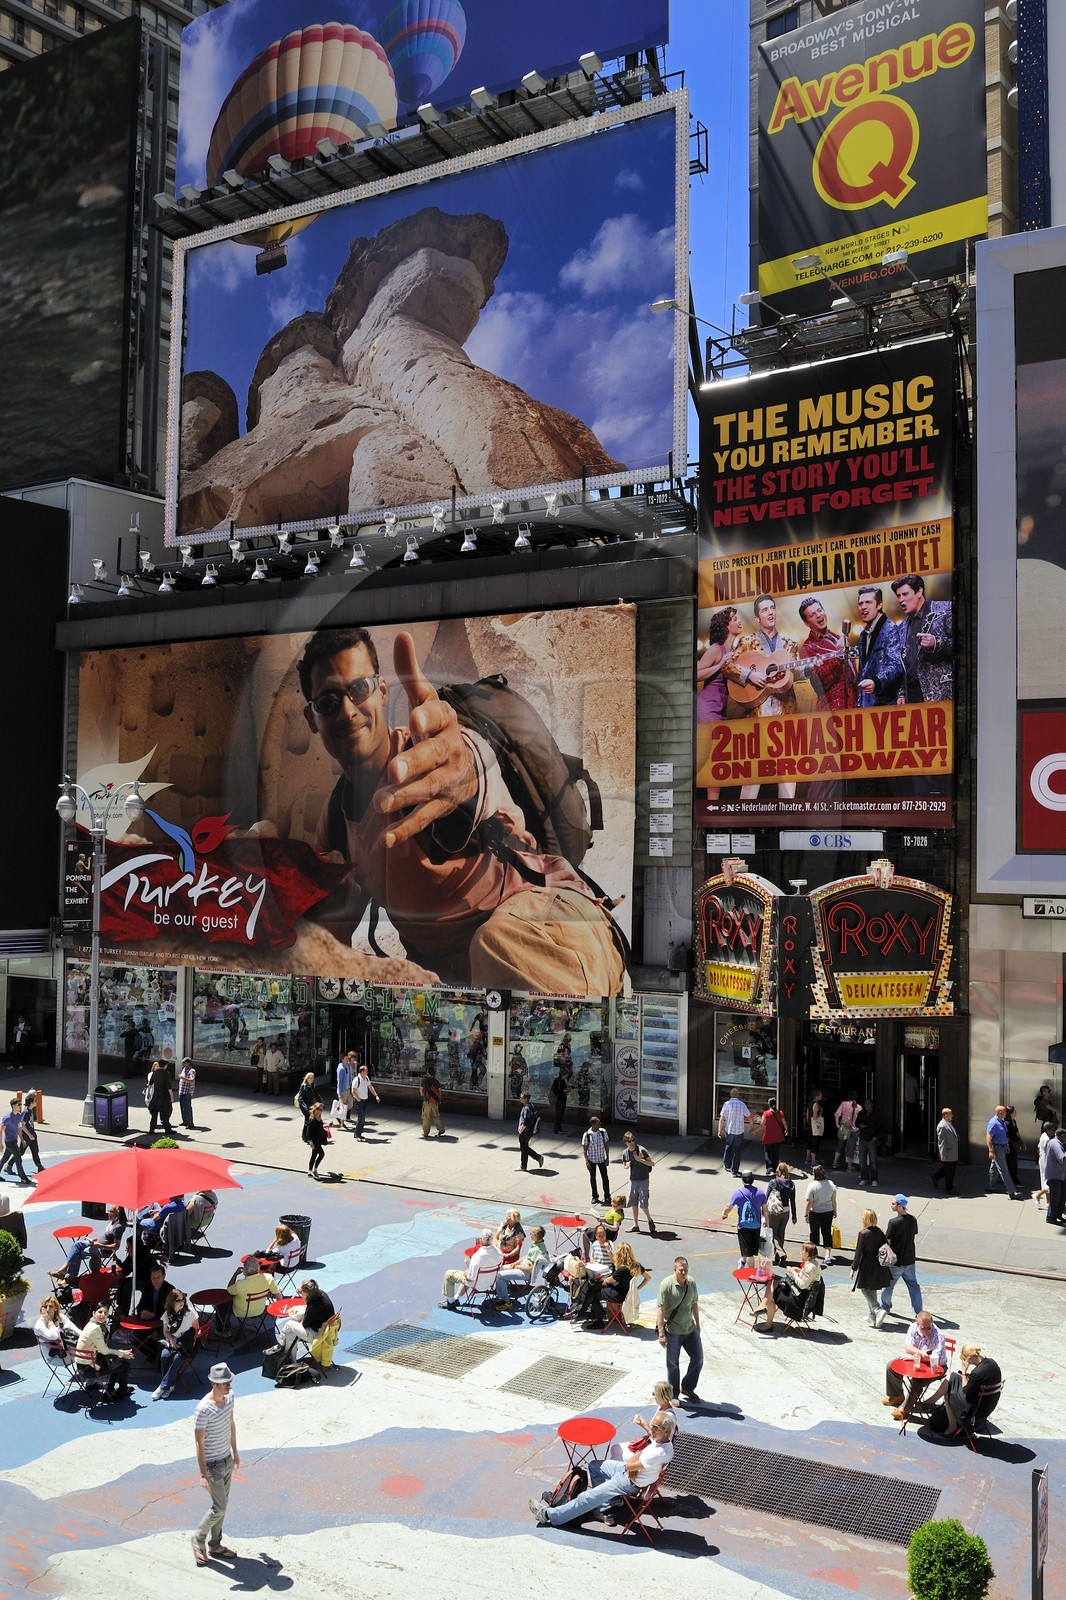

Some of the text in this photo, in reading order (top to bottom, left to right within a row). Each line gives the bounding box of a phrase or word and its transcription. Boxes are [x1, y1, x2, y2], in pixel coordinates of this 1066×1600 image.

[770, 19, 854, 62] BROADWAY'S
[811, 7, 920, 60] BEST MUSICAL
[768, 23, 974, 133] Avenue
[813, 94, 919, 210] Q
[825, 245, 839, 255] NEW
[840, 239, 863, 251] WORLD
[864, 230, 890, 243] STAGES
[795, 253, 873, 281] TELECHARGE.COM
[876, 249, 885, 258] or
[828, 265, 906, 292] AVENUEQ.COM
[713, 375, 934, 447] THE MUSIC
[713, 414, 940, 473] YOU REMEMBER.
[713, 445, 934, 503] THE STORY YOU'LL
[713, 476, 938, 527] NEVER FORGET.
[713, 523, 941, 571] ELVIS PRESLEY JERRY LEE LEWIS CARL PERKINS JOHNNY CASH
[711, 707, 947, 762] 2nd SMASH YEAR
[711, 748, 947, 781] ON BROADWAY!
[741, 802, 777, 812] Nederlander
[779, 801, 805, 812] Theatre,
[805, 802, 812, 812] W.
[813, 802, 820, 811] 41
[833, 801, 892, 811] Ticketmaster.com
[892, 802, 901, 811] or
[901, 800, 947, 811] 877-250-2929
[824, 833, 852, 848] CBS
[903, 835, 928, 848] TS-7026
[65, 897, 89, 905] EXHIBIT
[91, 853, 266, 940] Turkey
[1048, 905, 1066, 914] AD
[154, 906, 238, 932] be our guest
[703, 895, 762, 952] ROXY
[828, 901, 935, 956] ROXY
[103, 947, 122, 955] TURKEY
[783, 915, 797, 1000] ROXY
[226, 976, 442, 1018] GRAND SLAM
[709, 972, 751, 991] DELICATESSEN
[846, 982, 923, 999] DELICATESSEN
[810, 1022, 876, 1038] RESTAURAN
